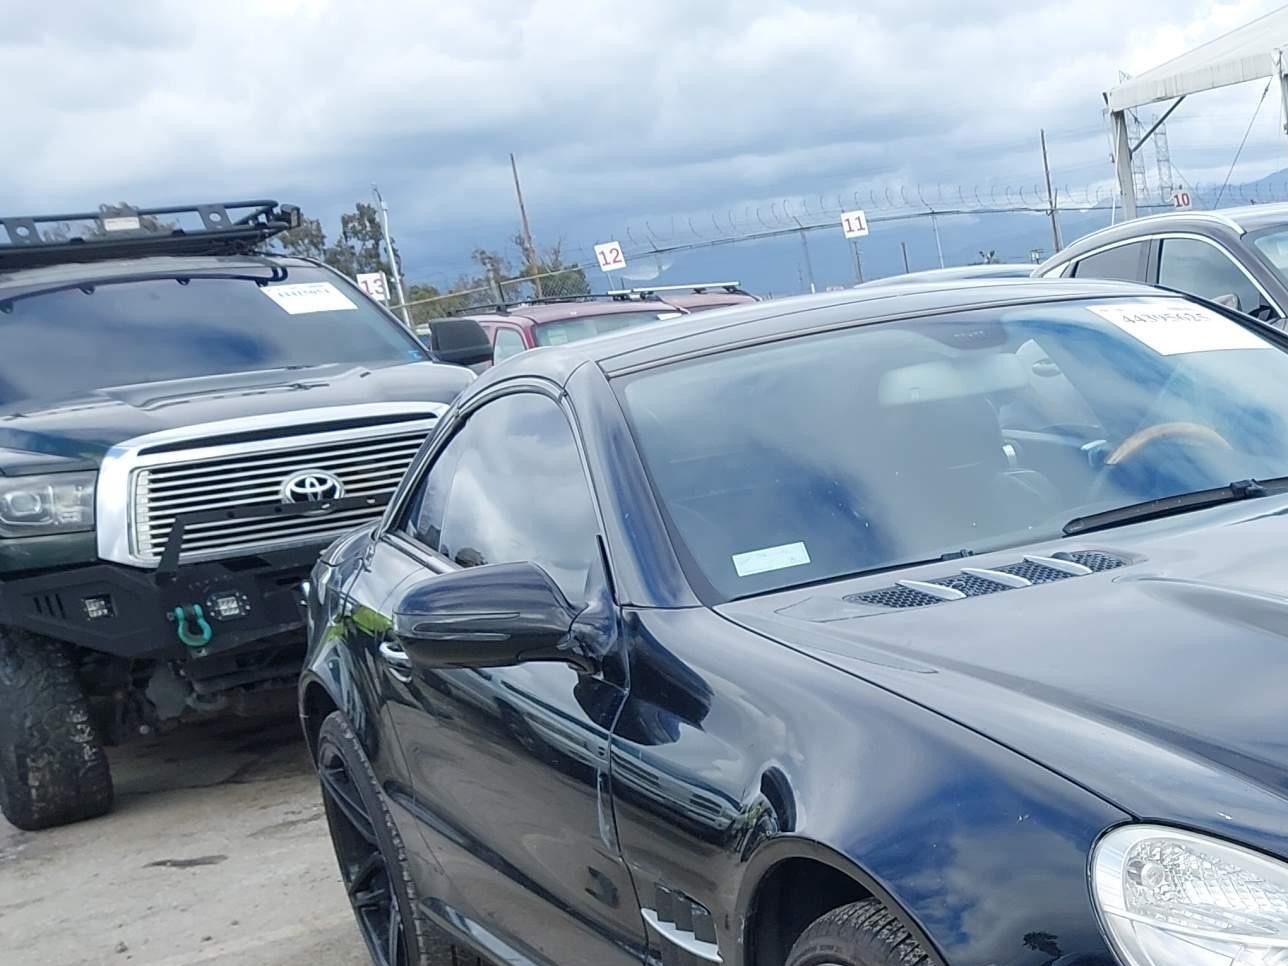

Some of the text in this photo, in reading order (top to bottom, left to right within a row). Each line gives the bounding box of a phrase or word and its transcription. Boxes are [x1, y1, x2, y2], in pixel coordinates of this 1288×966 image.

[1173, 192, 1190, 207] 10
[844, 215, 866, 233] 11
[598, 247, 622, 266] 12
[361, 279, 385, 296] 13
